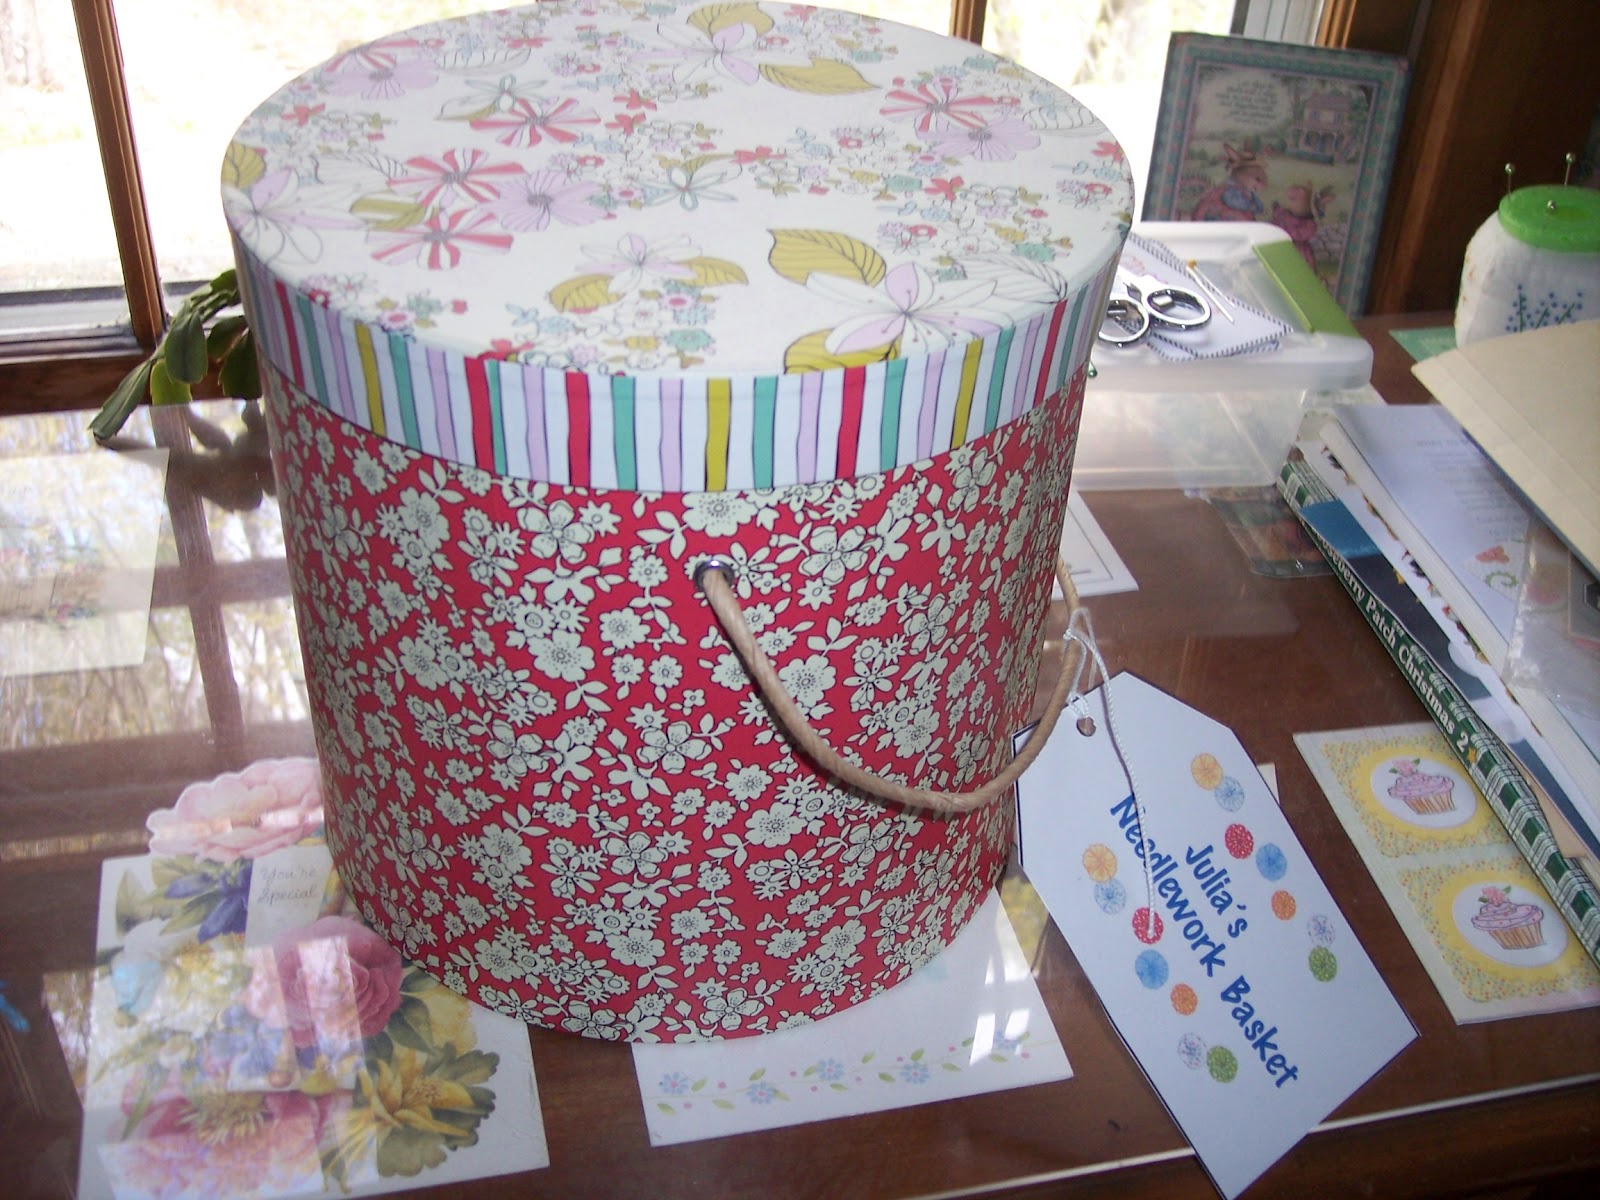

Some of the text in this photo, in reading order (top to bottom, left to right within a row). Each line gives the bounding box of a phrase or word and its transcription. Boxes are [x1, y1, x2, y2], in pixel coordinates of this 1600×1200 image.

[1317, 534, 1469, 753] oseberry Patch Christmas 2
[257, 881, 318, 906] Special
[1110, 794, 1298, 1088] Needlework Basket
[1186, 845, 1248, 938] Julia's
